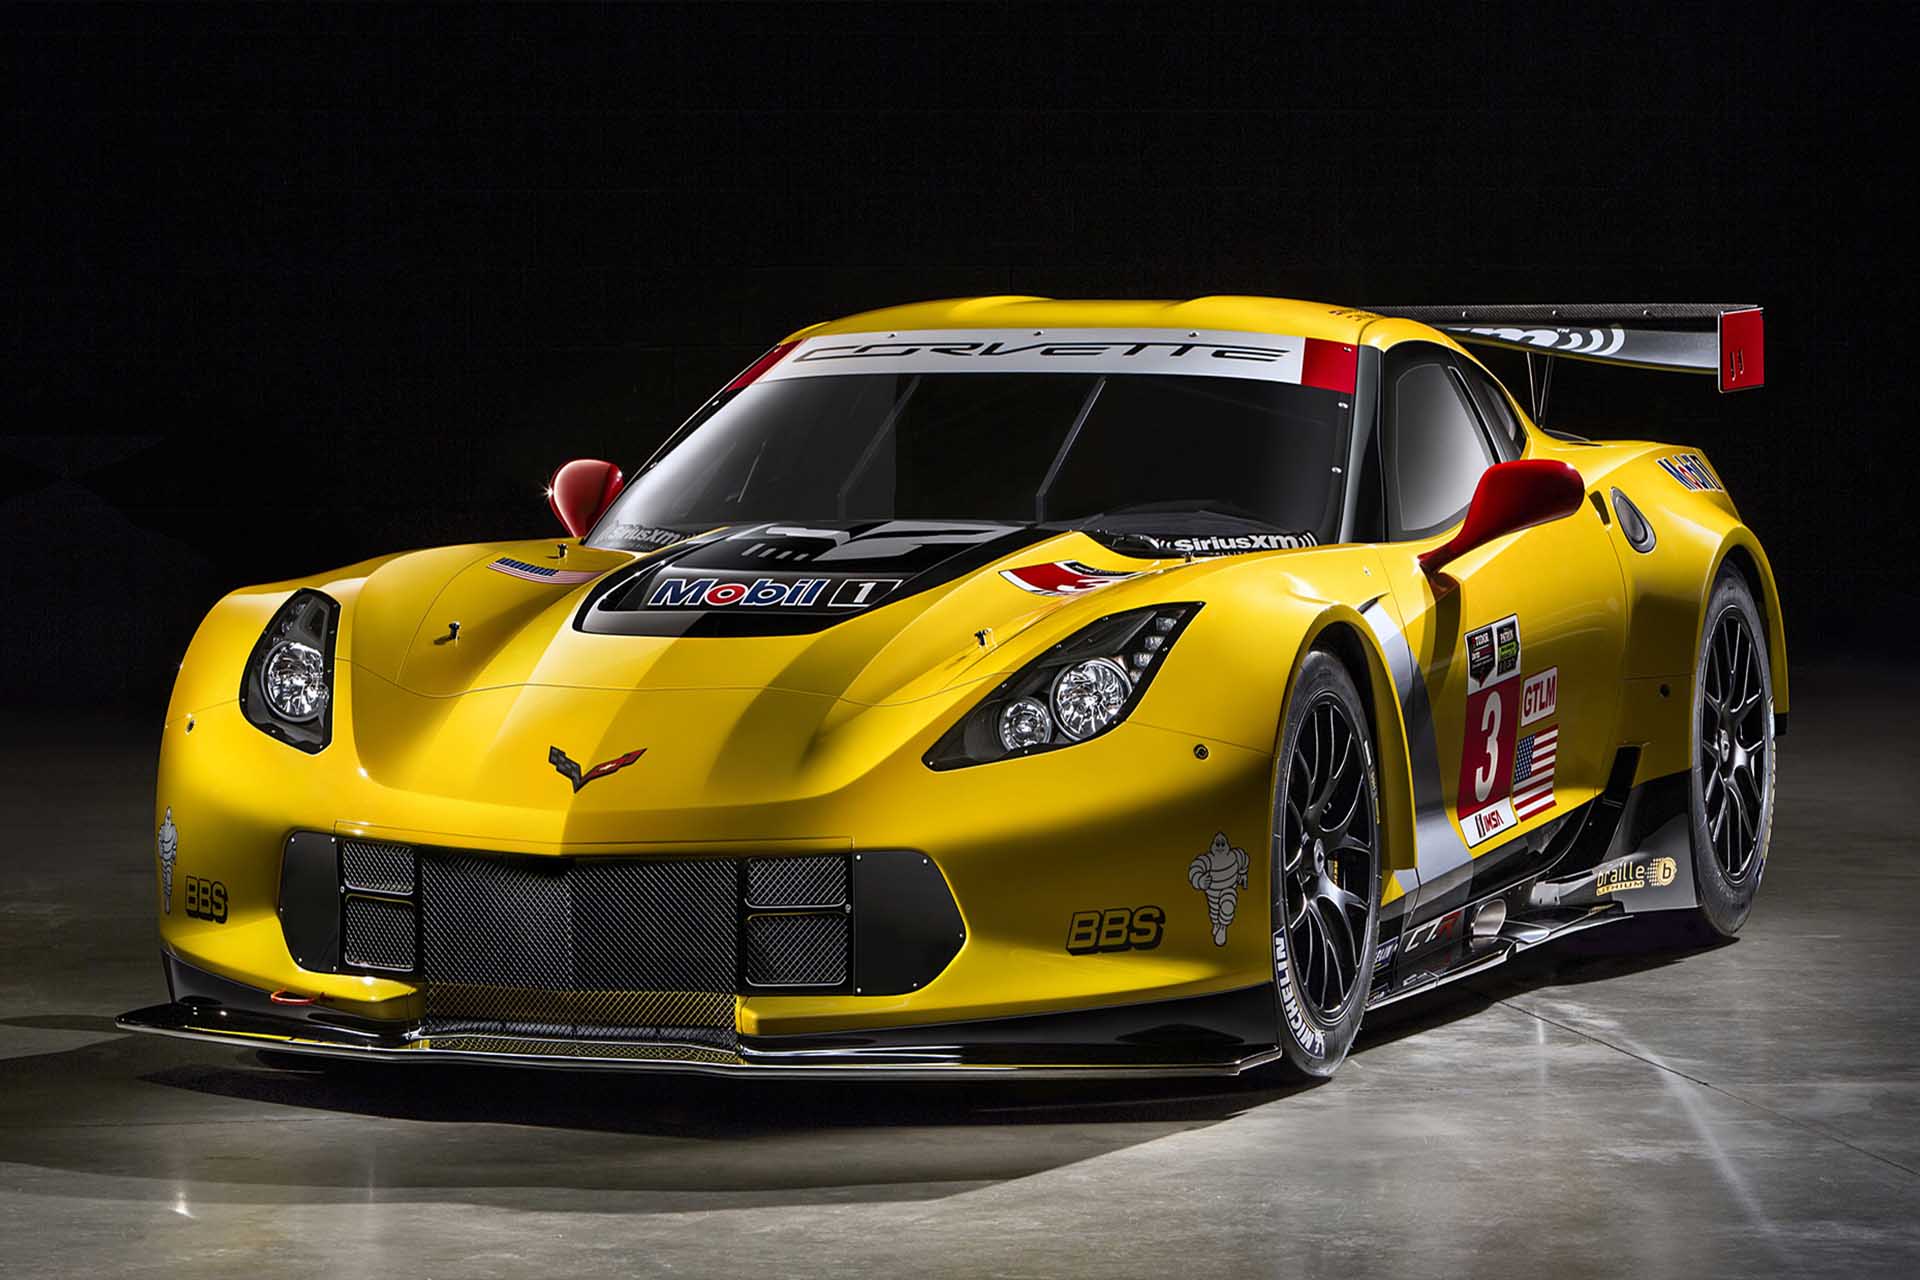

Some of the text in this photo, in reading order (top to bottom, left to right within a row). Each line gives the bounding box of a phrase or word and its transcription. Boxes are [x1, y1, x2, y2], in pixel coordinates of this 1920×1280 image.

[793, 340, 1290, 364] CORVETTE
[648, 578, 831, 606] Mobil
[1523, 674, 1557, 718] GTLM
[1474, 690, 1502, 803] 3
[1596, 861, 1646, 887] braille
[185, 875, 229, 925] BBS
[1066, 904, 1166, 956] BBS
[1274, 935, 1316, 1050] MICHELIN
